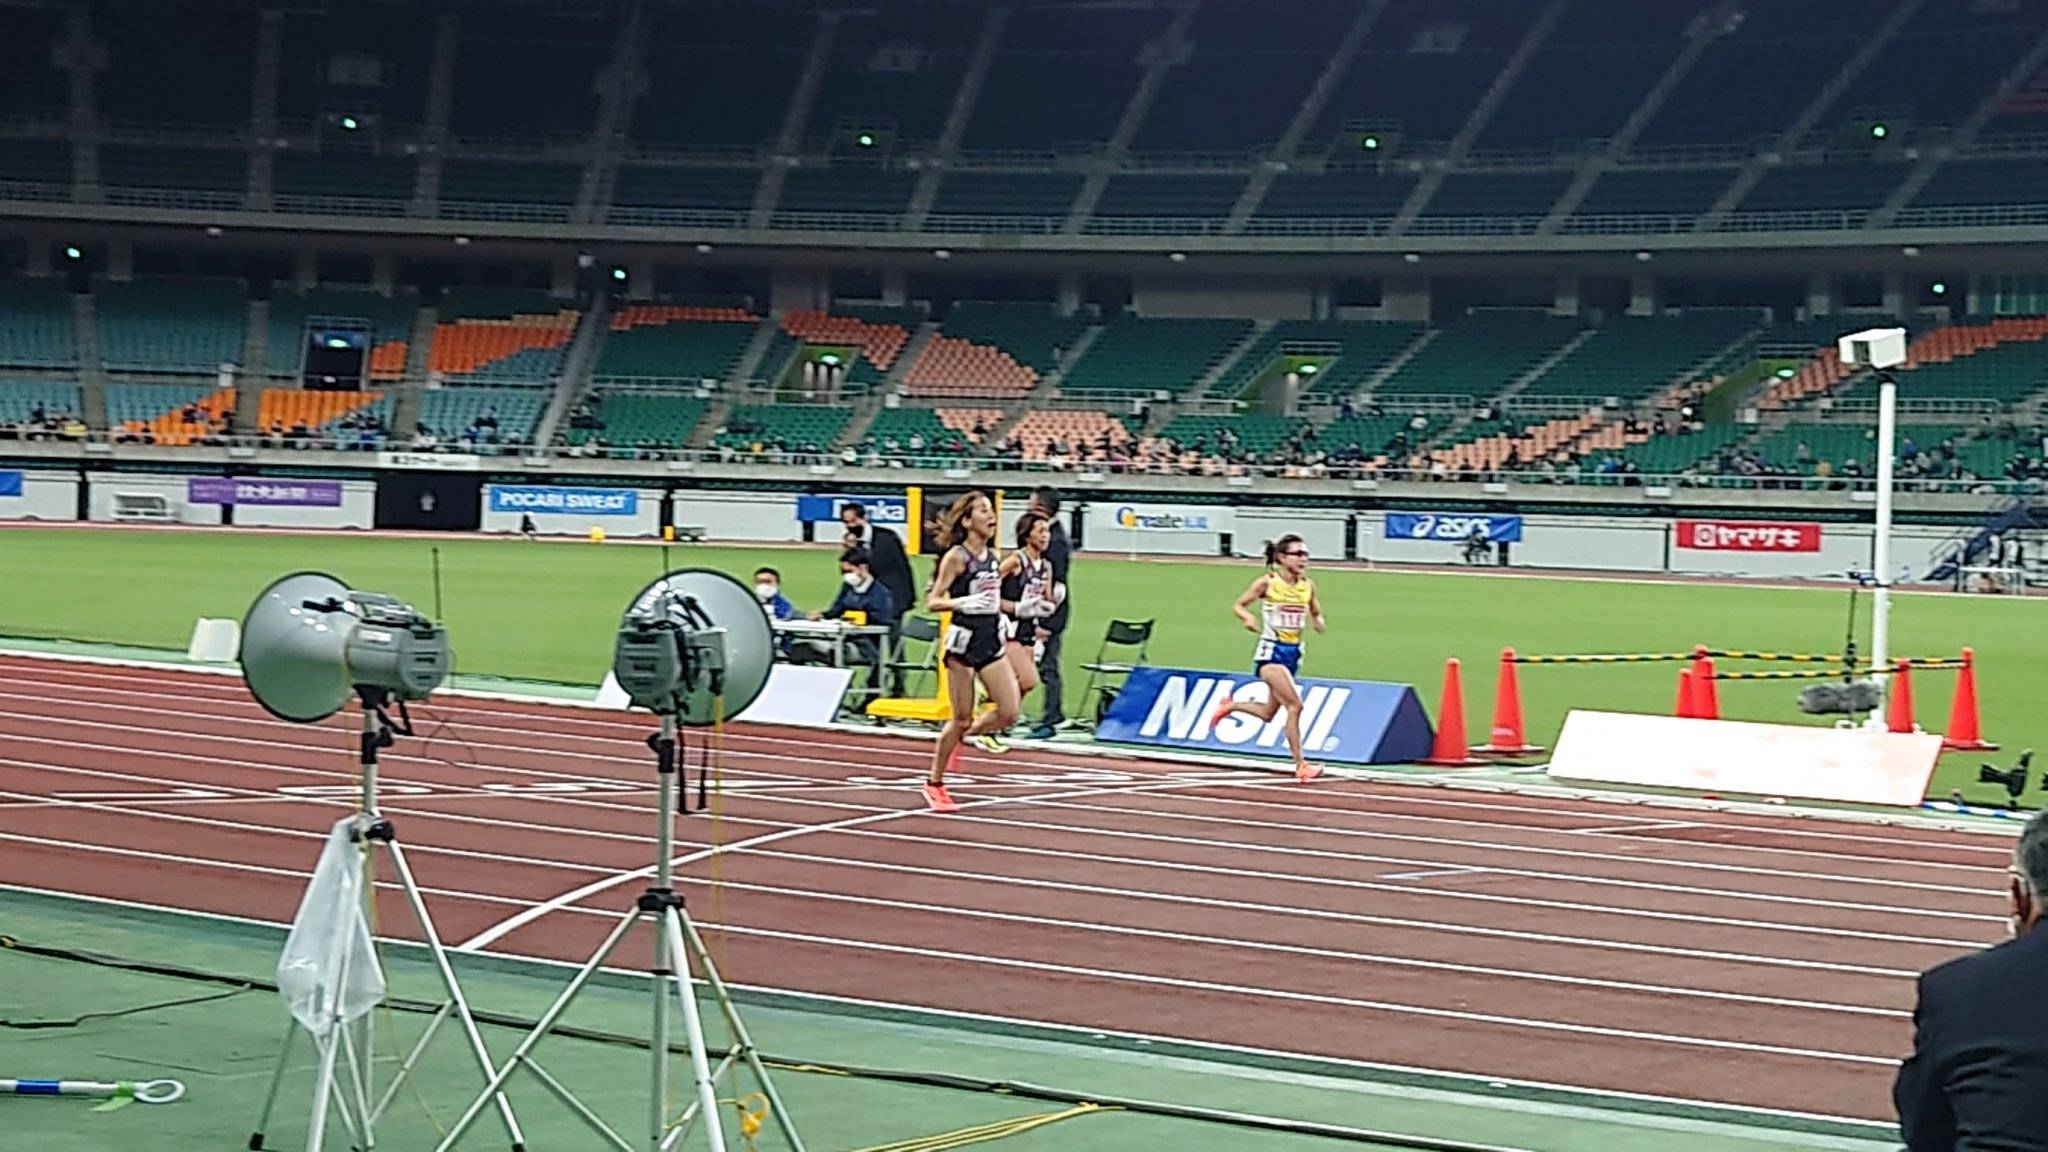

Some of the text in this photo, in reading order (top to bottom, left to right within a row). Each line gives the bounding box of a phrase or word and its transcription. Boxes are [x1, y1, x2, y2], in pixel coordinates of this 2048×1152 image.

[500, 492, 626, 509] POCARI SWEAT
[832, 500, 905, 520] Dnka
[1717, 526, 1802, 548] ヤマザキ
[1139, 675, 1351, 751] NISHI
